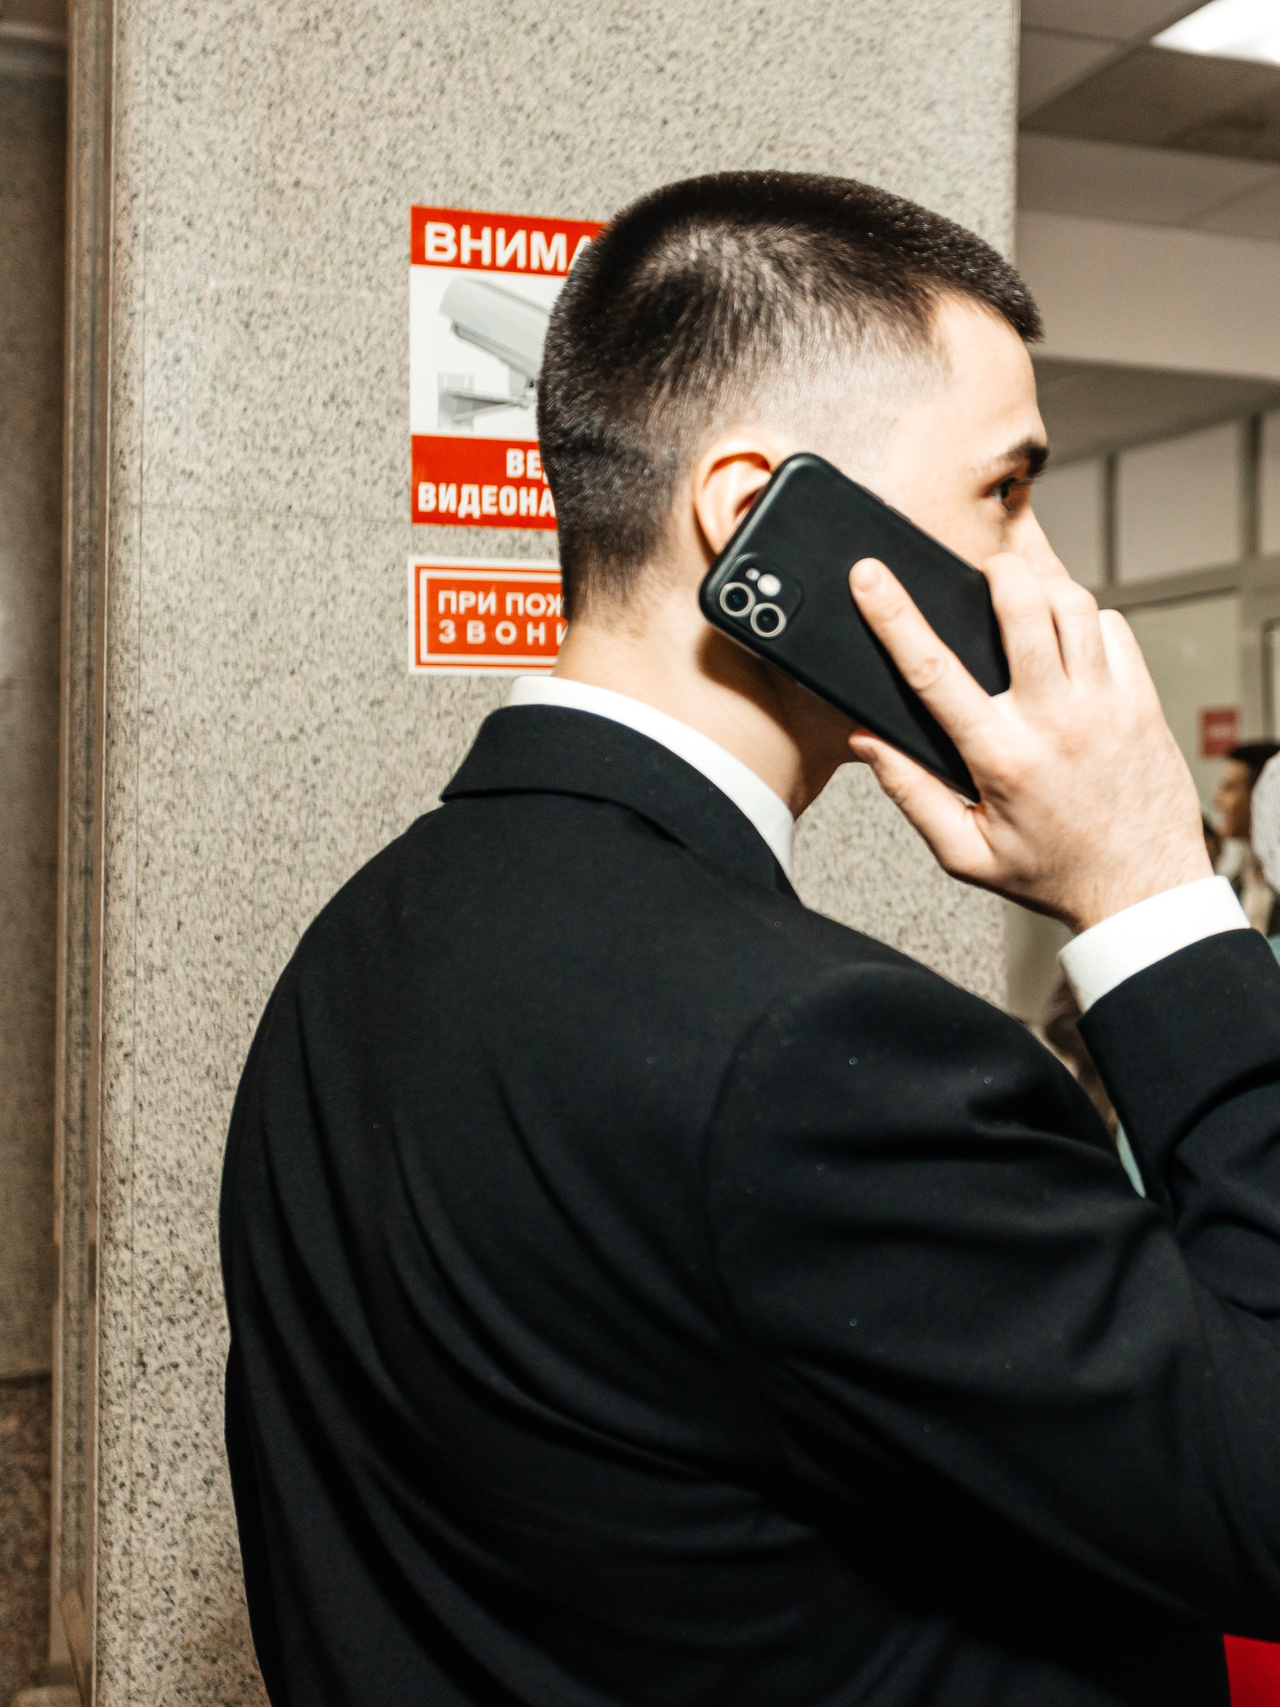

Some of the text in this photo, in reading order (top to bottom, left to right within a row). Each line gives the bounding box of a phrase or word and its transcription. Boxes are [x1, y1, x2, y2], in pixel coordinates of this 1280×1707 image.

[506, 448, 549, 484] ВЕ
[418, 482, 556, 519] ВИДЕОНА
[438, 590, 564, 617] ПРИ ПОЖ
